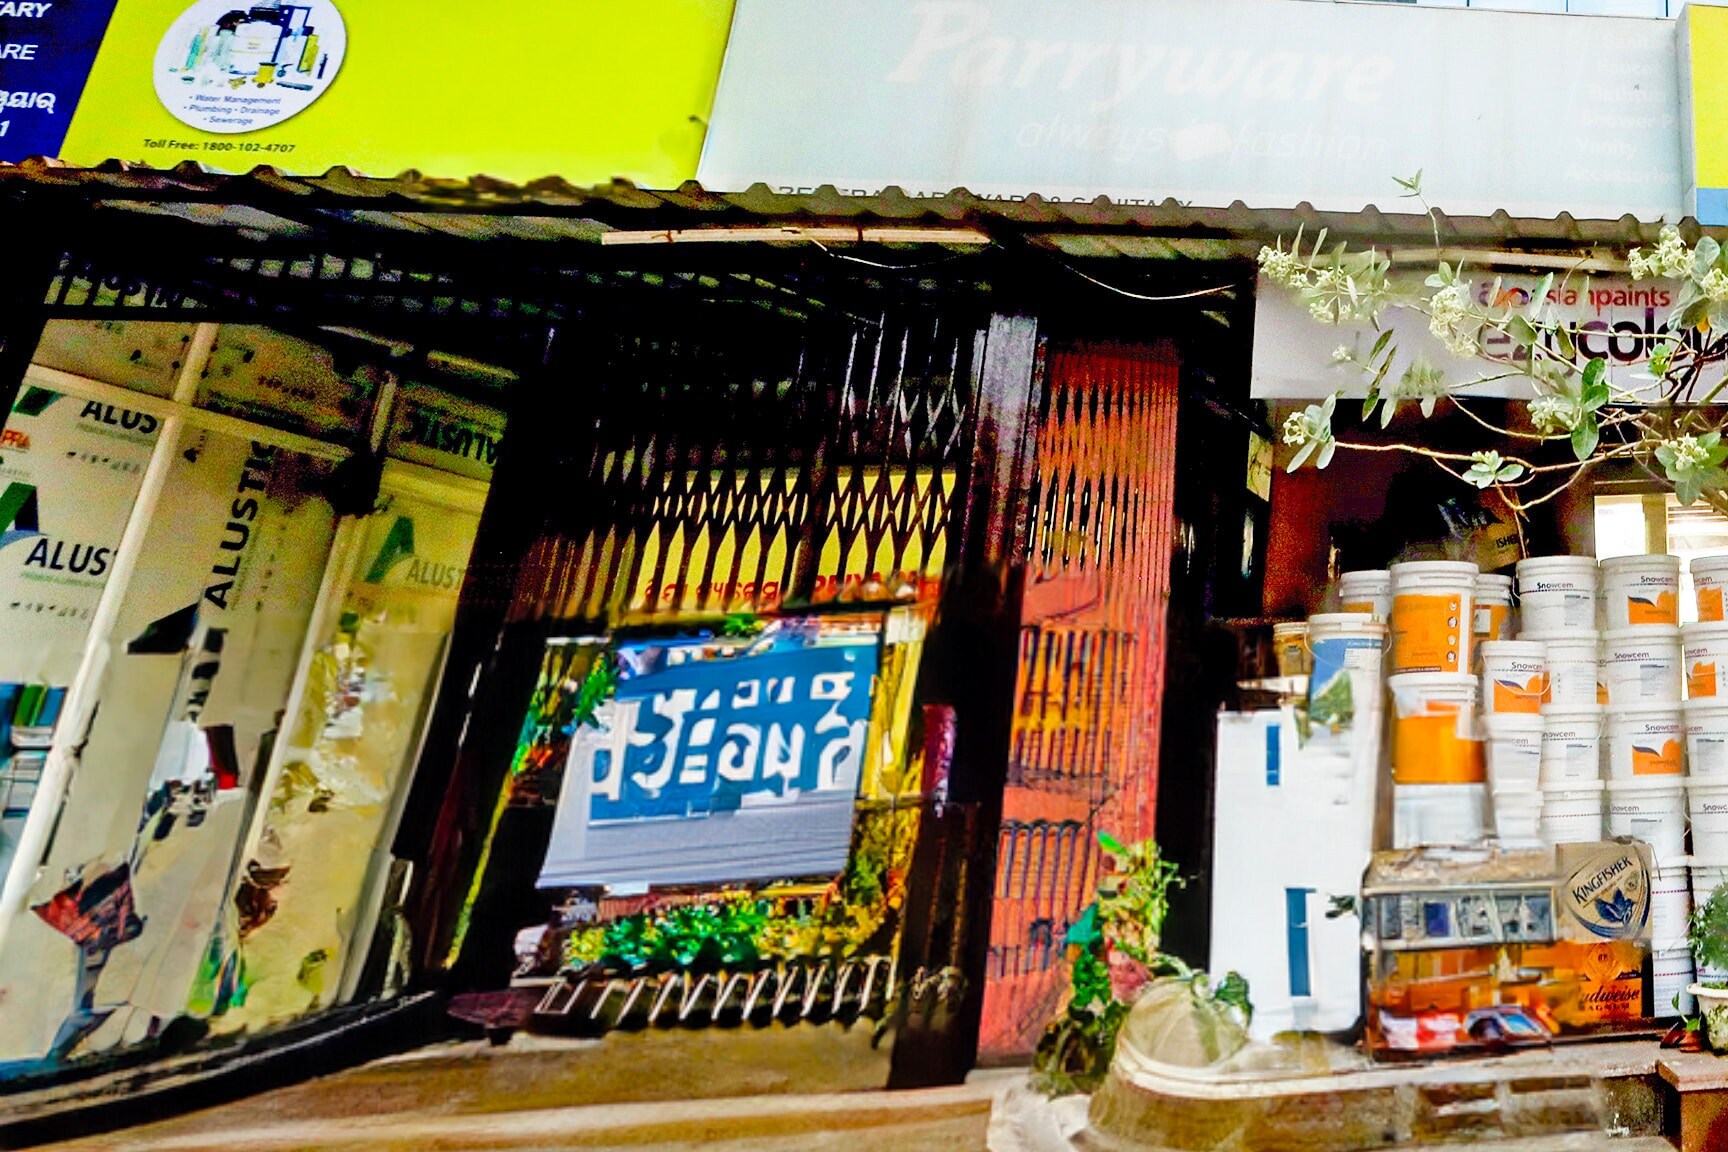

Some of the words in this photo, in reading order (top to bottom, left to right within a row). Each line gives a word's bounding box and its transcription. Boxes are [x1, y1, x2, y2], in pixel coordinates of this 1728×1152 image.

[0, 1, 52, 18] ARY
[0, 43, 38, 60] RE
[887, 0, 1395, 113] Parryware
[189, 104, 233, 114] Plumbing
[209, 116, 254, 125] Sewerage
[144, 138, 166, 148] Toll
[168, 140, 199, 150] Free:
[1230, 116, 1390, 162] fashion
[24, 538, 119, 576] ALUS
[1537, 582, 1574, 590] Snowcem
